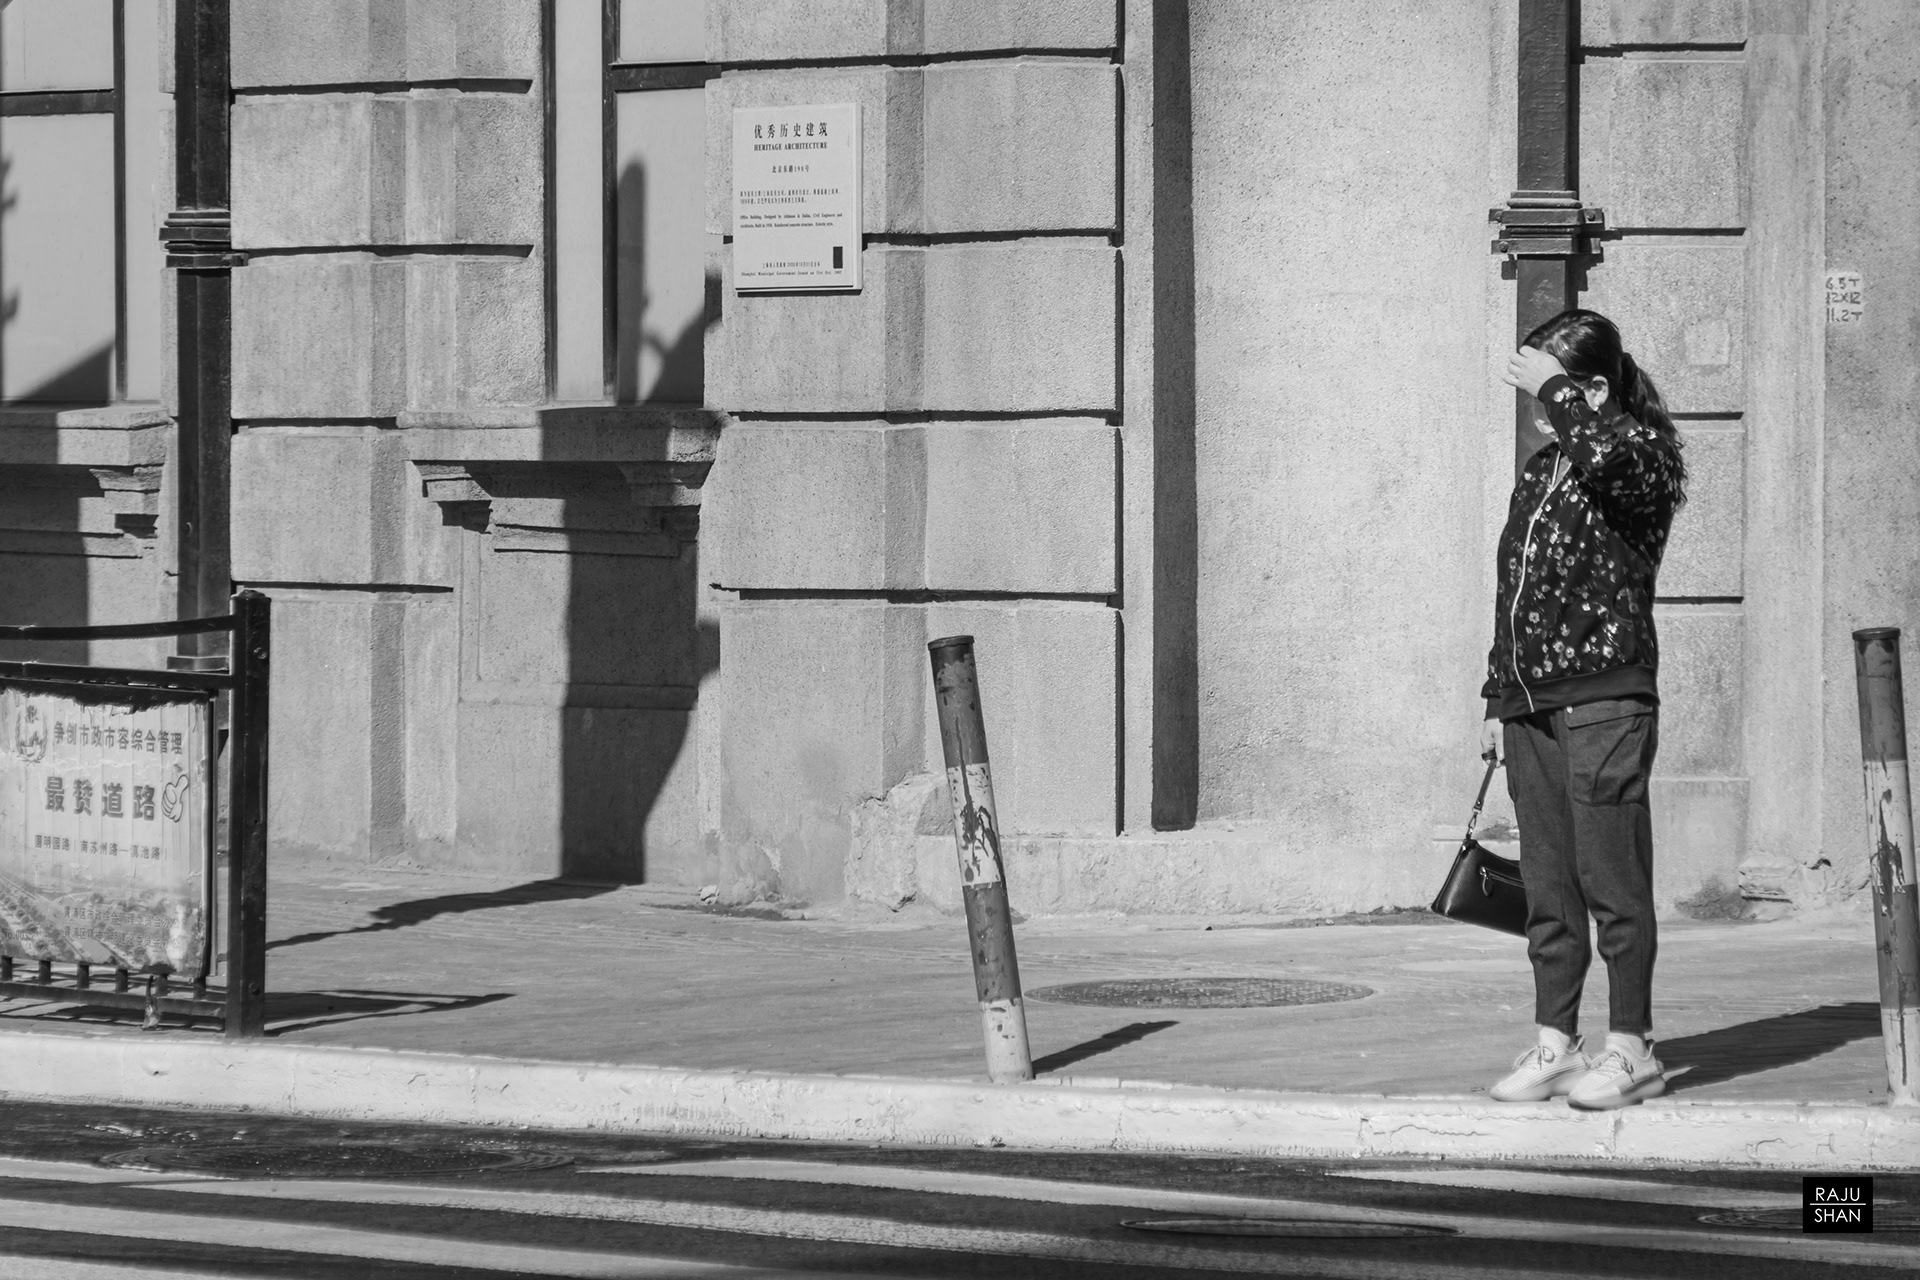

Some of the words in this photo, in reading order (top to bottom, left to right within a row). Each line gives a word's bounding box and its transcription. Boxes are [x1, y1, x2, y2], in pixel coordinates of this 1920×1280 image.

[754, 122, 828, 139] 优秀历史建筑
[754, 143, 782, 151] HERITAGE
[784, 142, 828, 150] ARCHITECTURE
[54, 720, 182, 755] 争创市政市容综合管理
[45, 776, 155, 821] 最赞道路
